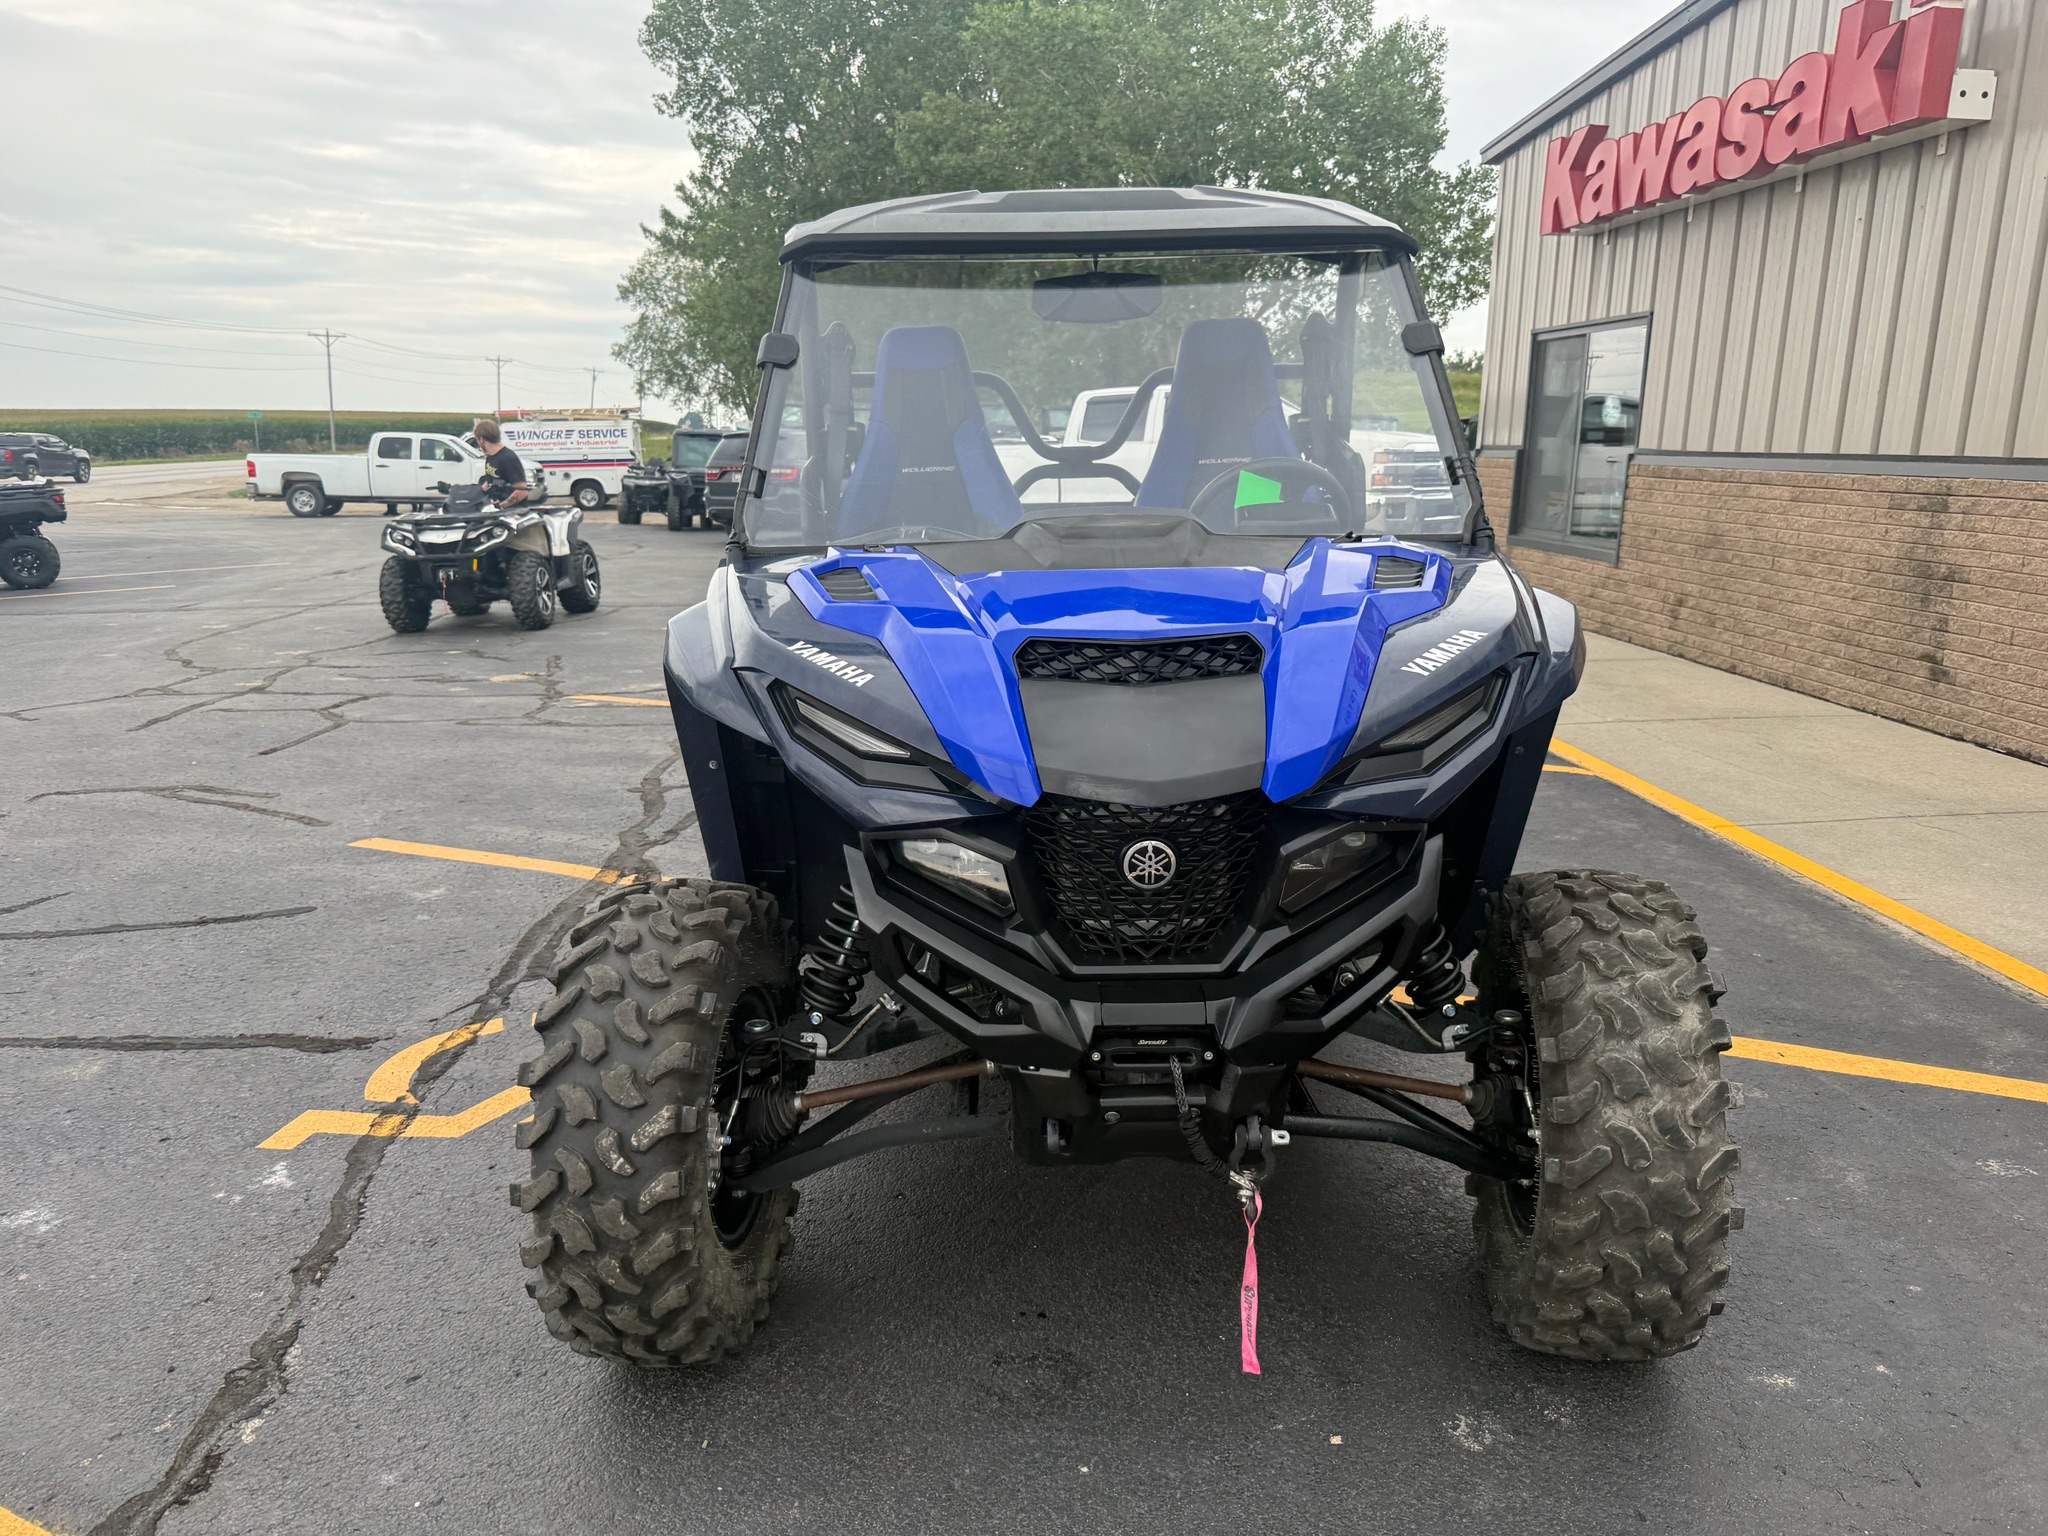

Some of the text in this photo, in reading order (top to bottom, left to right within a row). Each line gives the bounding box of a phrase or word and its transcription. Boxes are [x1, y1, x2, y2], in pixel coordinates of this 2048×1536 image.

[1541, 0, 1963, 235] Kawasaki
[516, 428, 628, 440] WINGER SERVICE
[786, 640, 875, 687] YAMAHA
[1400, 629, 1489, 677] YAMAHA
